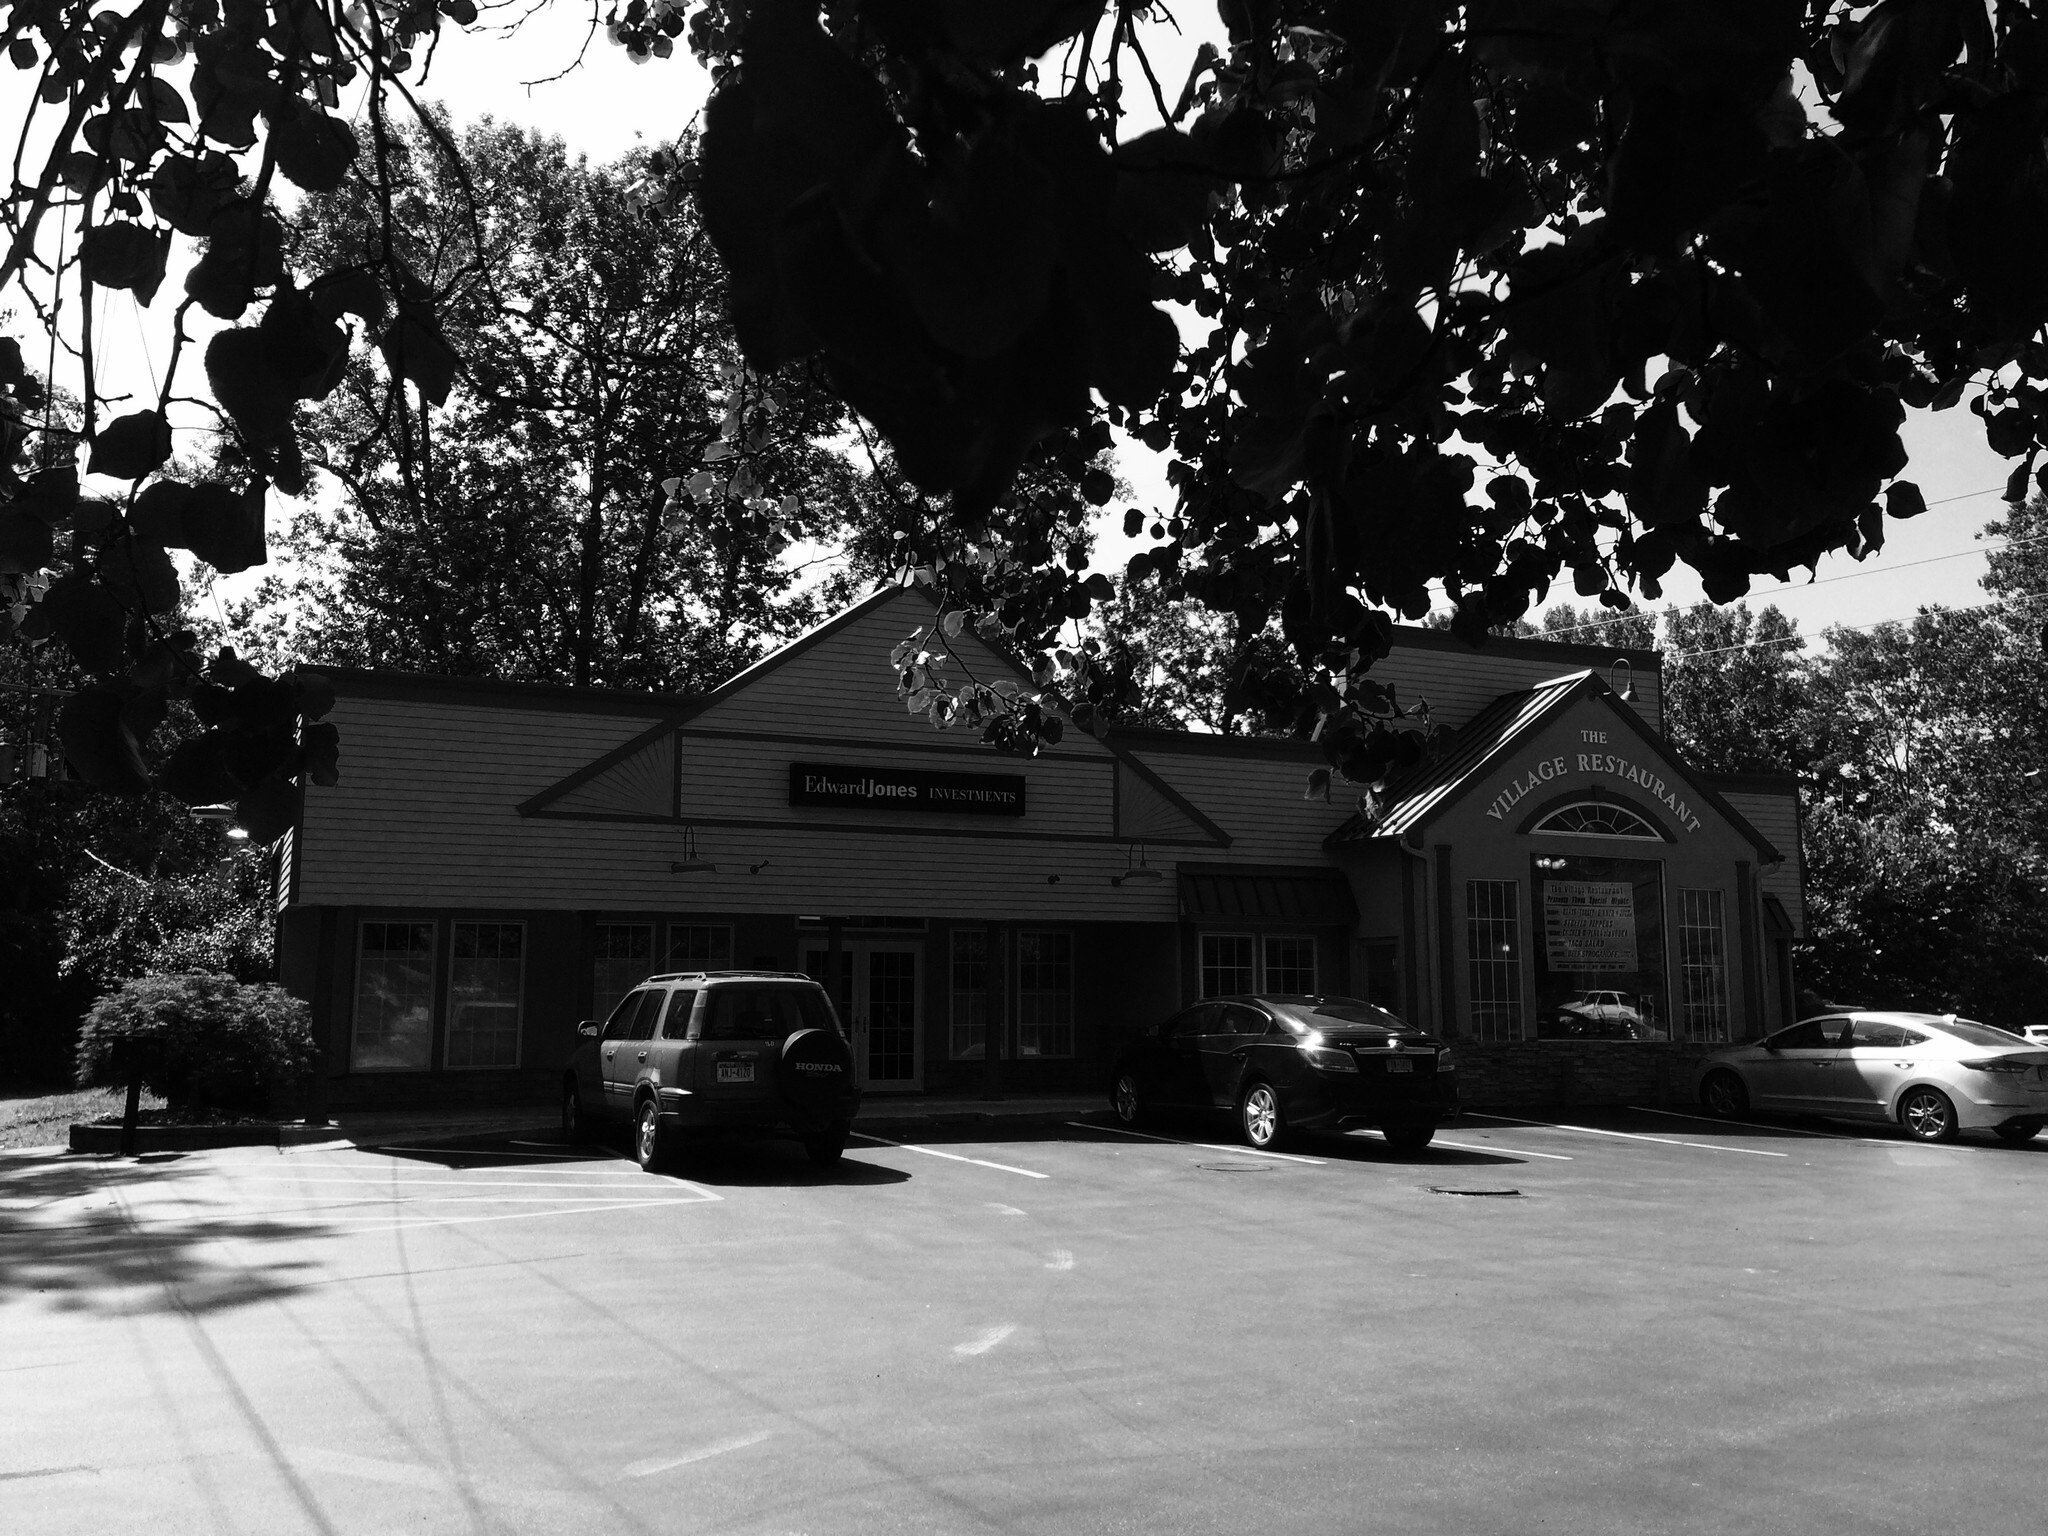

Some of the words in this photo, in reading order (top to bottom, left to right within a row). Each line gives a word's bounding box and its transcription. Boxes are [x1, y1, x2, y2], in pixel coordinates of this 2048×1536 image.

[1580, 730, 1608, 745] THE
[928, 787, 1017, 804] INVESTMENTS
[1486, 756, 1568, 821] VILLAGE
[1576, 753, 1701, 833] RESTAURANT
[795, 1062, 843, 1072] HONDA
